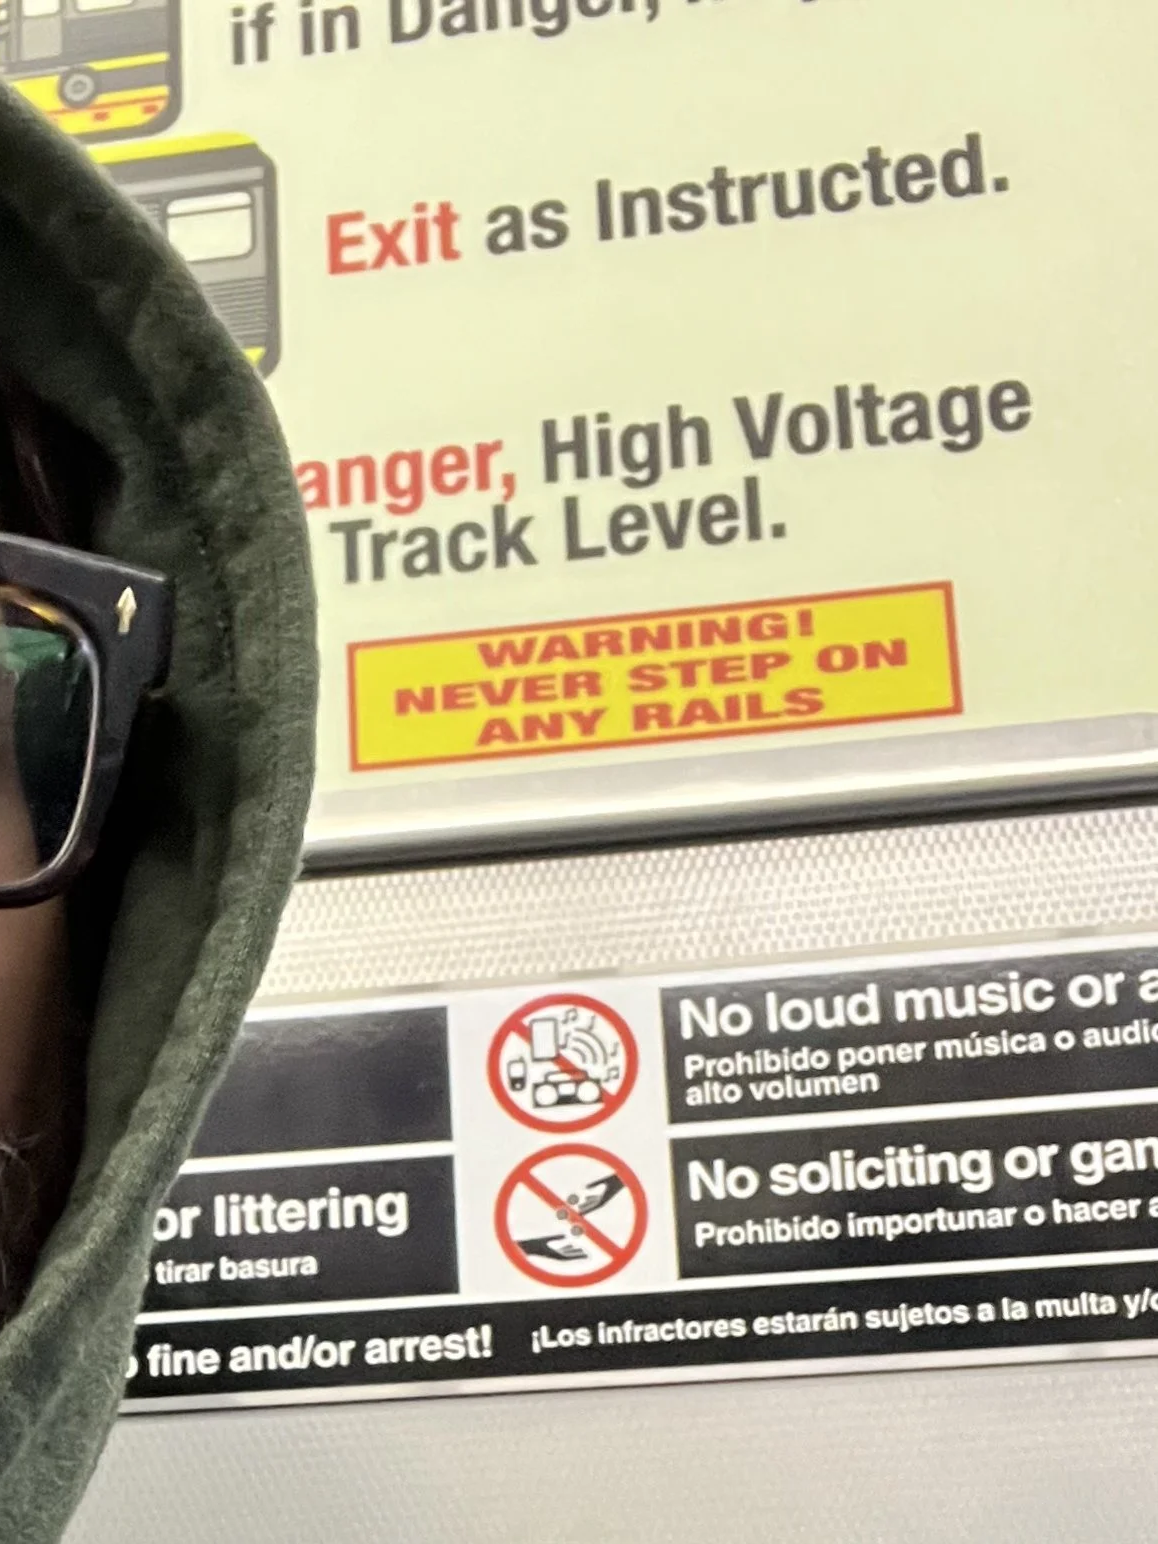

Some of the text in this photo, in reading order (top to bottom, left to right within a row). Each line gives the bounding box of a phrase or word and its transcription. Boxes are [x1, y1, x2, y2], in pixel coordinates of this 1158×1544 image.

[233, 2, 274, 65] if
[301, 0, 360, 56] in
[327, 133, 1009, 275] Exit as Instructed.
[295, 379, 1031, 516] anger, High Voltage
[329, 475, 786, 583] Track Level.
[477, 607, 813, 669] WARNING!
[394, 639, 908, 717] NEVER STEP ON
[476, 687, 825, 749] ANY RAILS
[678, 995, 754, 1040] No
[765, 982, 881, 1034] loud
[893, 970, 1056, 1023] music
[1067, 971, 1126, 1009] or
[684, 1046, 831, 1080] Prohibido
[837, 1041, 927, 1074] poner
[933, 1029, 1047, 1060] música
[1053, 1029, 1076, 1051] o
[685, 1072, 880, 1107] alto volumen
[687, 1158, 760, 1202] No
[769, 1143, 994, 1194] soliciting
[1003, 1143, 1059, 1180] or
[151, 1186, 409, 1242] or littering
[694, 1215, 841, 1248] Prohibido
[847, 1204, 1018, 1242] importunar
[1023, 1204, 1046, 1226] o
[1051, 1195, 1142, 1227] hacer
[154, 1255, 318, 1285] tirar basura
[598, 1318, 747, 1345] infractores
[752, 1306, 859, 1336] estarán
[864, 1302, 971, 1333] sujetos
[977, 1302, 996, 1322] a
[1001, 1296, 1029, 1321] la
[1034, 1291, 1117, 1319] multa
[146, 1343, 221, 1377] fine
[229, 1334, 356, 1373] and/or
[364, 1324, 492, 1365] arrest!
